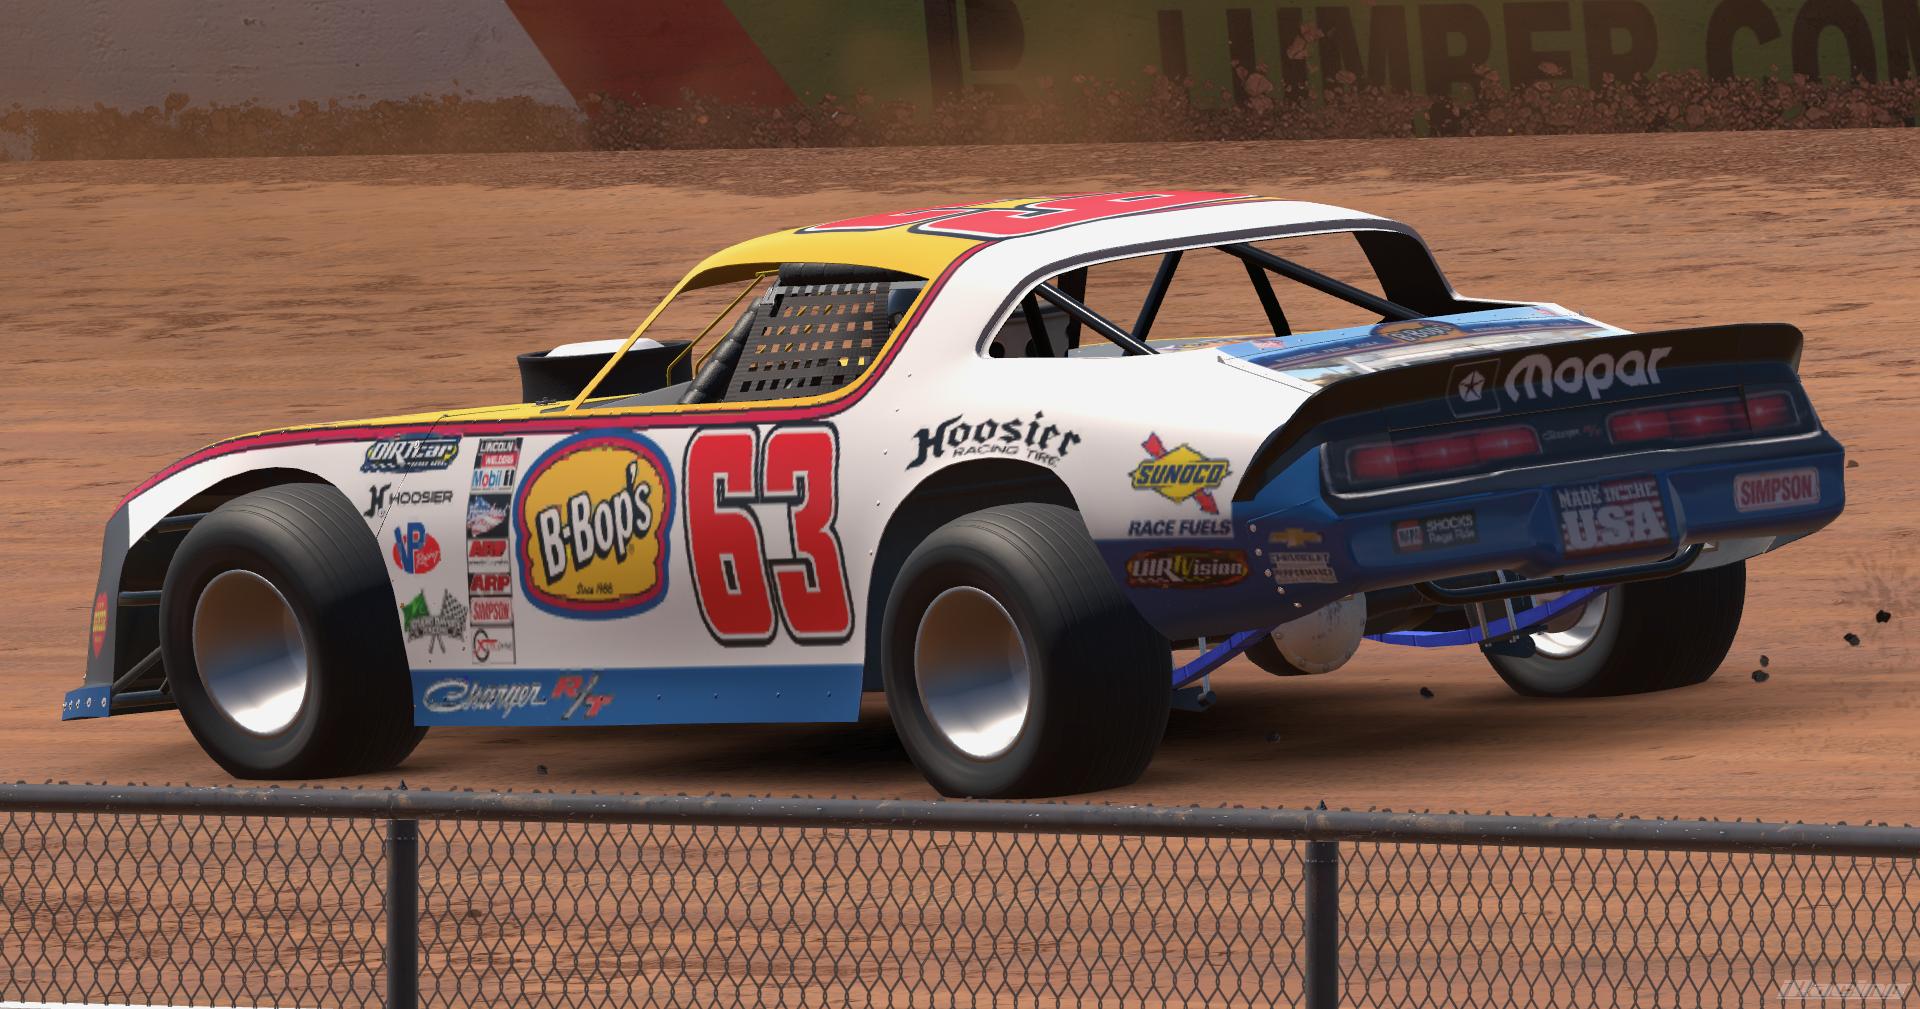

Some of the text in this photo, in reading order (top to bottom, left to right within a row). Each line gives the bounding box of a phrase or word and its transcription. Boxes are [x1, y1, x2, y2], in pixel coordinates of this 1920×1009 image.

[1504, 347, 1673, 402] Mopar
[904, 410, 1081, 472] Hoosier
[952, 444, 1019, 458] RACING
[472, 468, 502, 488] Mobil
[1137, 463, 1225, 486] SUNOCO
[389, 490, 454, 505] HOOSIER
[1557, 485, 1603, 509] MADE
[1741, 475, 1813, 505] SIMPSON
[537, 460, 651, 585] B-Bop's
[681, 421, 856, 648] 63
[1128, 519, 1231, 537] RACE FUELS
[1561, 501, 1669, 550] USA
[394, 522, 426, 574] VP
[471, 575, 510, 591] ARP
[473, 602, 510, 620] SIMPSON
[423, 674, 613, 720] Charger R/T
